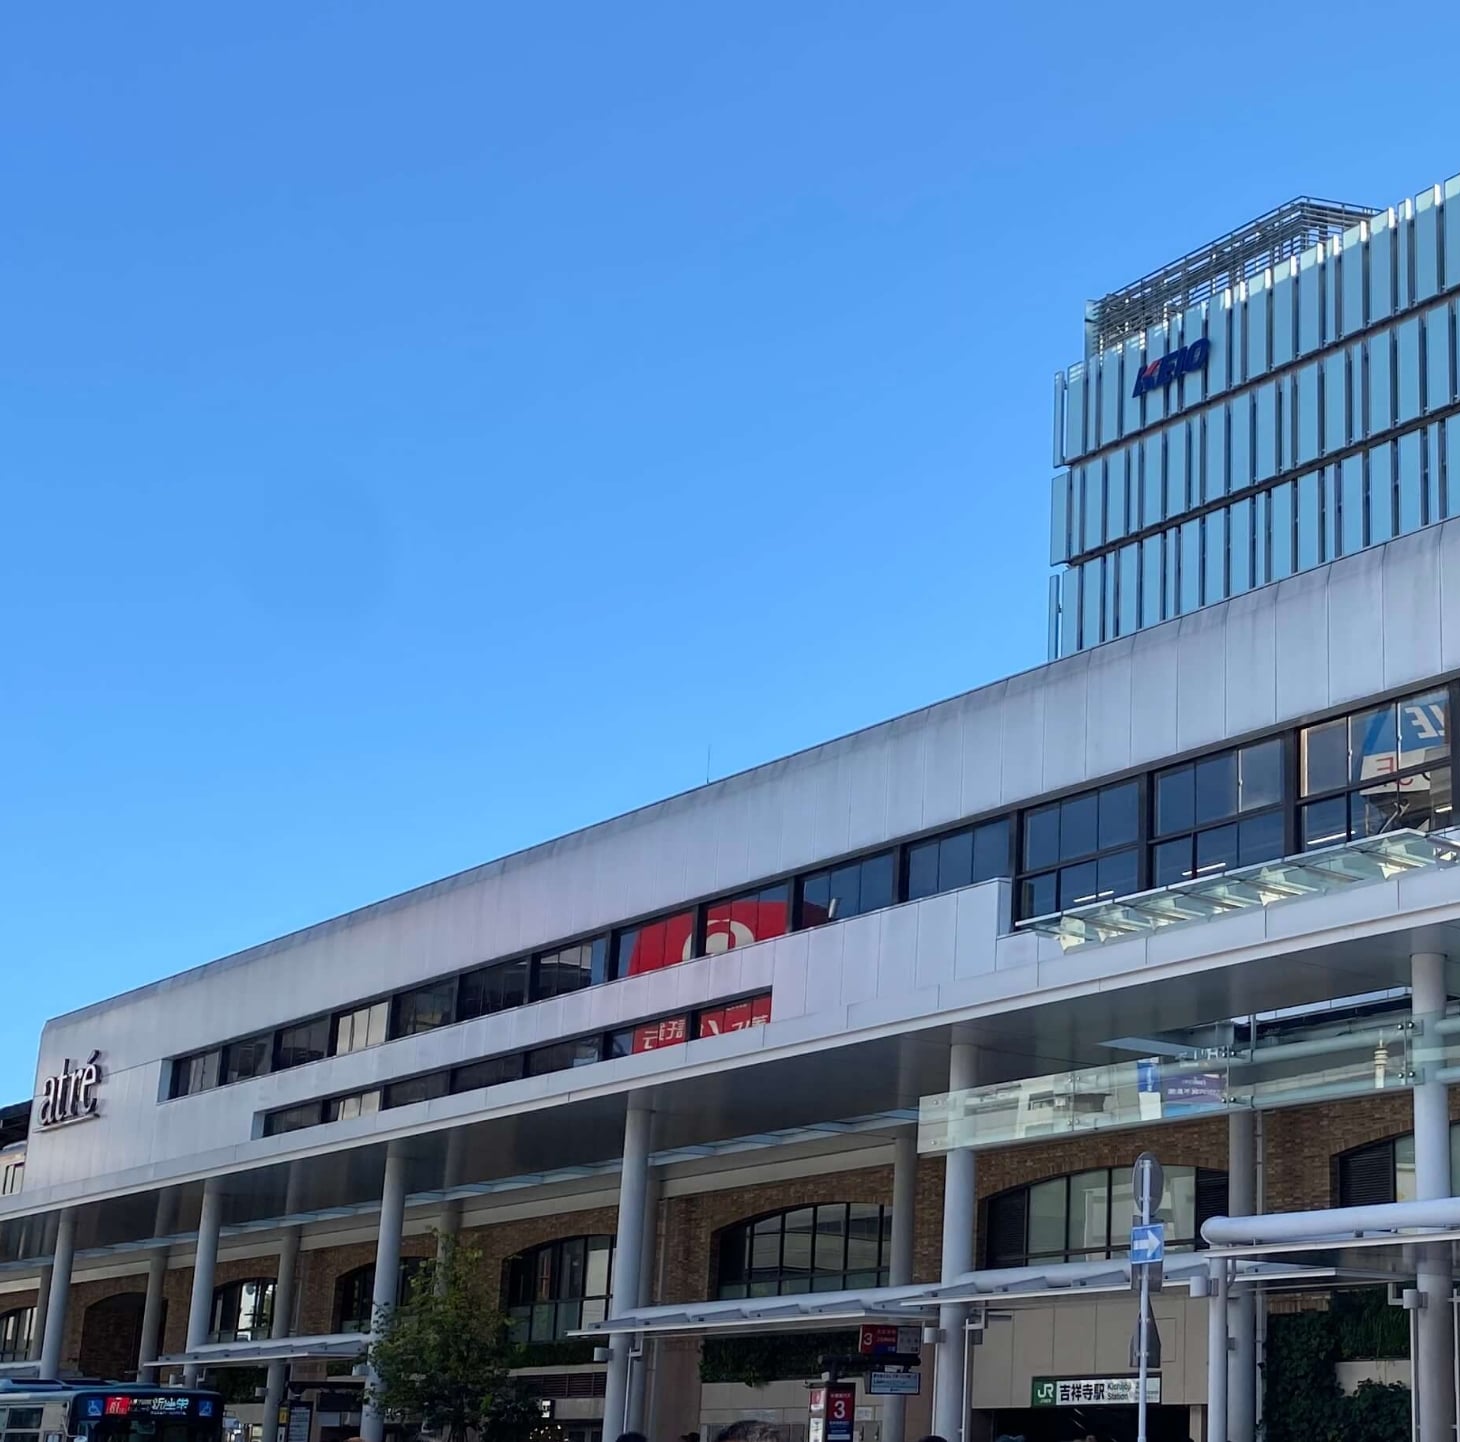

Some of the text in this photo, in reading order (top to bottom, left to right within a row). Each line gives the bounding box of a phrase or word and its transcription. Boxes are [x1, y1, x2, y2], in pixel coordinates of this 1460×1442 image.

[1132, 337, 1210, 398] KEIO
[38, 1049, 102, 1126] atré
[863, 1333, 873, 1346] 3
[1037, 1382, 1055, 1399] JR
[1060, 1383, 1105, 1401] 吉祥寺駅
[833, 1400, 846, 1419] 3
